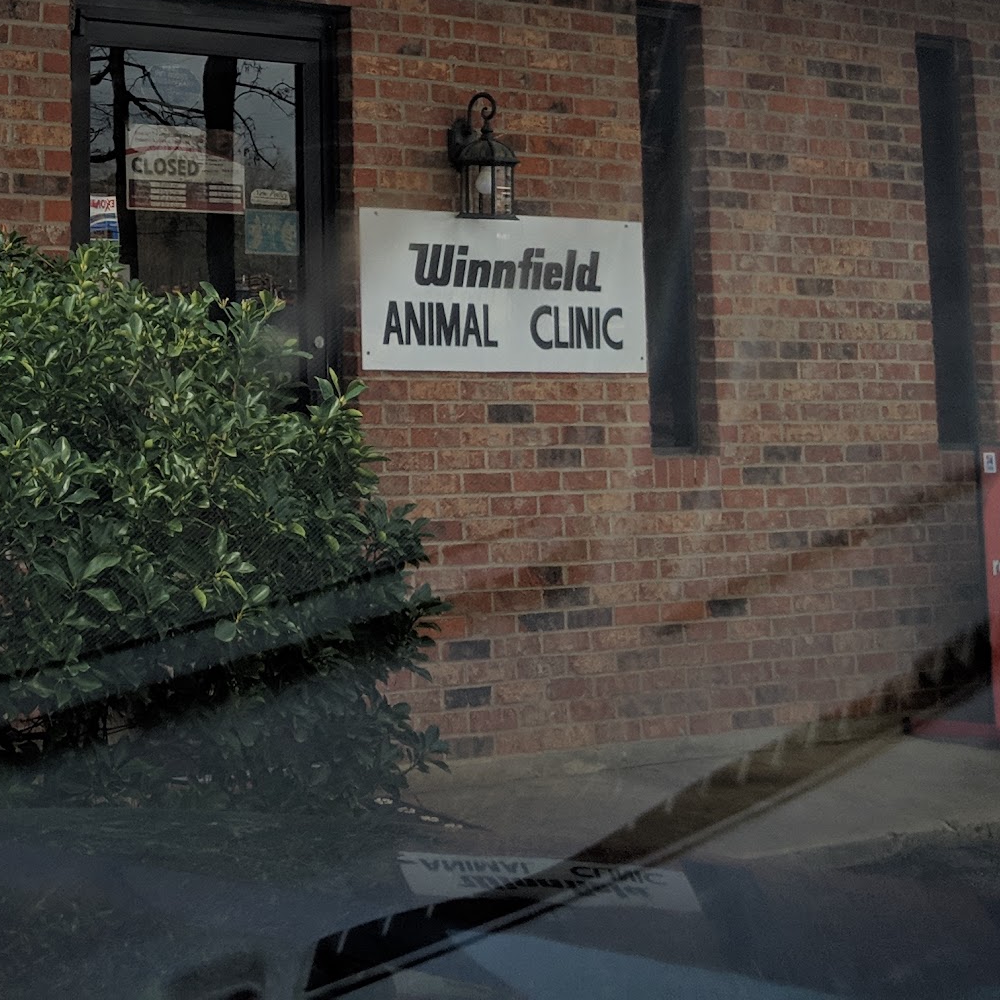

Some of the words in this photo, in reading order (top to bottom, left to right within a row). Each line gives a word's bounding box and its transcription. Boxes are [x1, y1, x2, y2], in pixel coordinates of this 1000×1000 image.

[132, 157, 199, 176] CLOSED
[409, 243, 601, 292] Winnfield
[383, 301, 498, 347] ANIMAL
[530, 305, 623, 350] CLINIC
